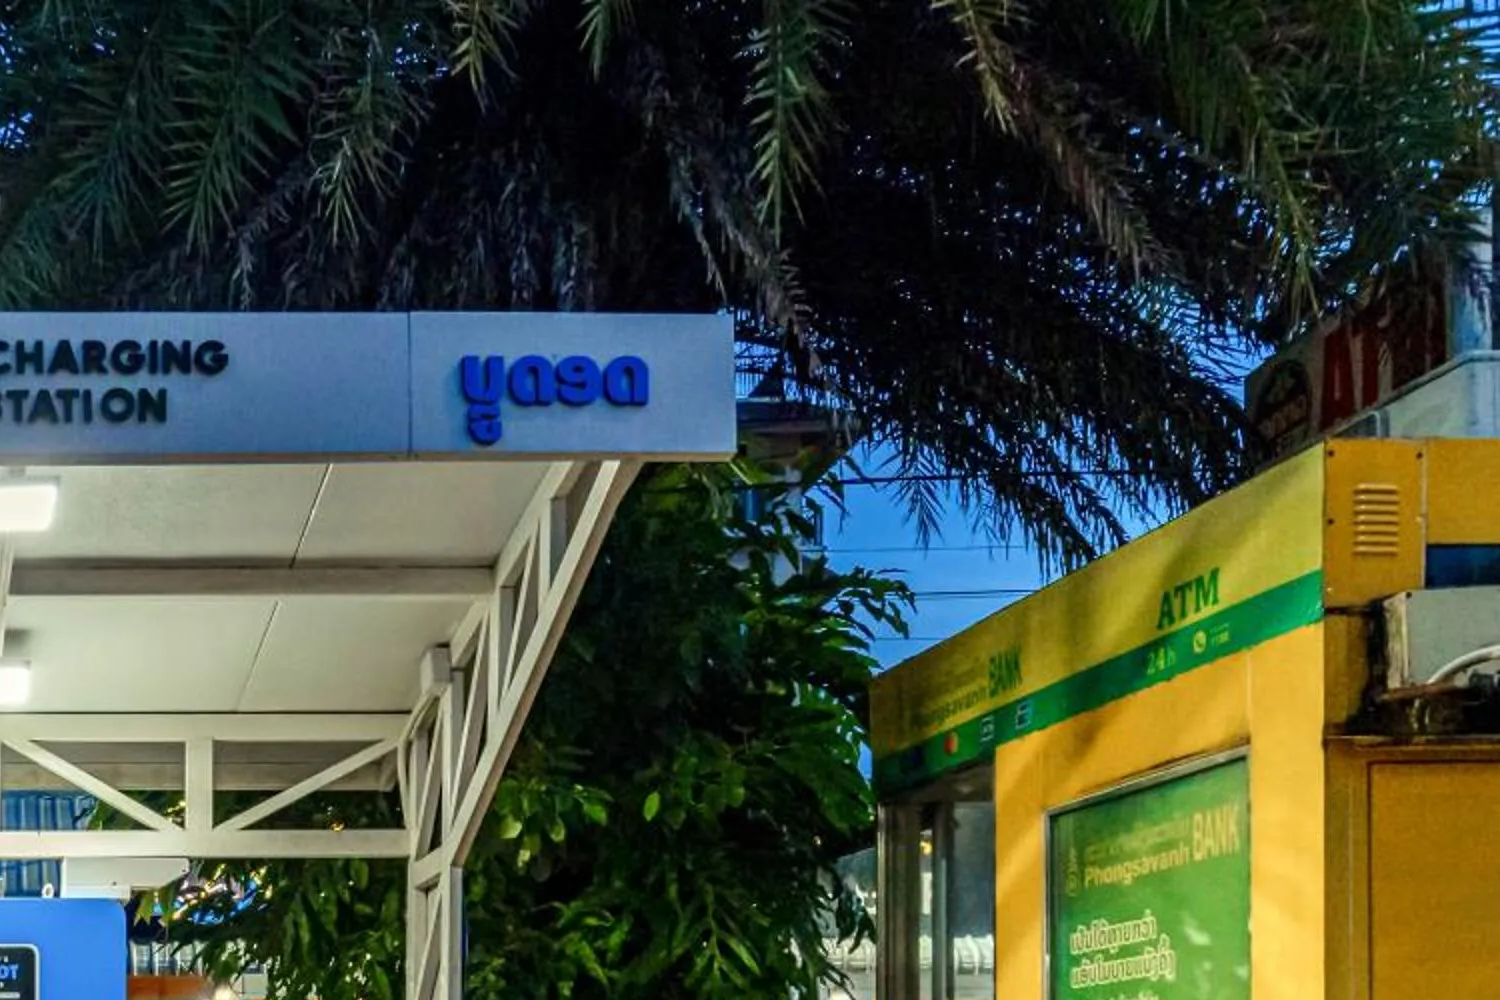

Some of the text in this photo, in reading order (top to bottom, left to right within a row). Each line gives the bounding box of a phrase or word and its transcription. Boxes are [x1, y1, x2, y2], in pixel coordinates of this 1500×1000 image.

[1155, 567, 1221, 630] ATM
[988, 645, 1024, 699] BANK
[1084, 841, 1190, 888] Phongsavanh
[1192, 802, 1240, 862] BANK
